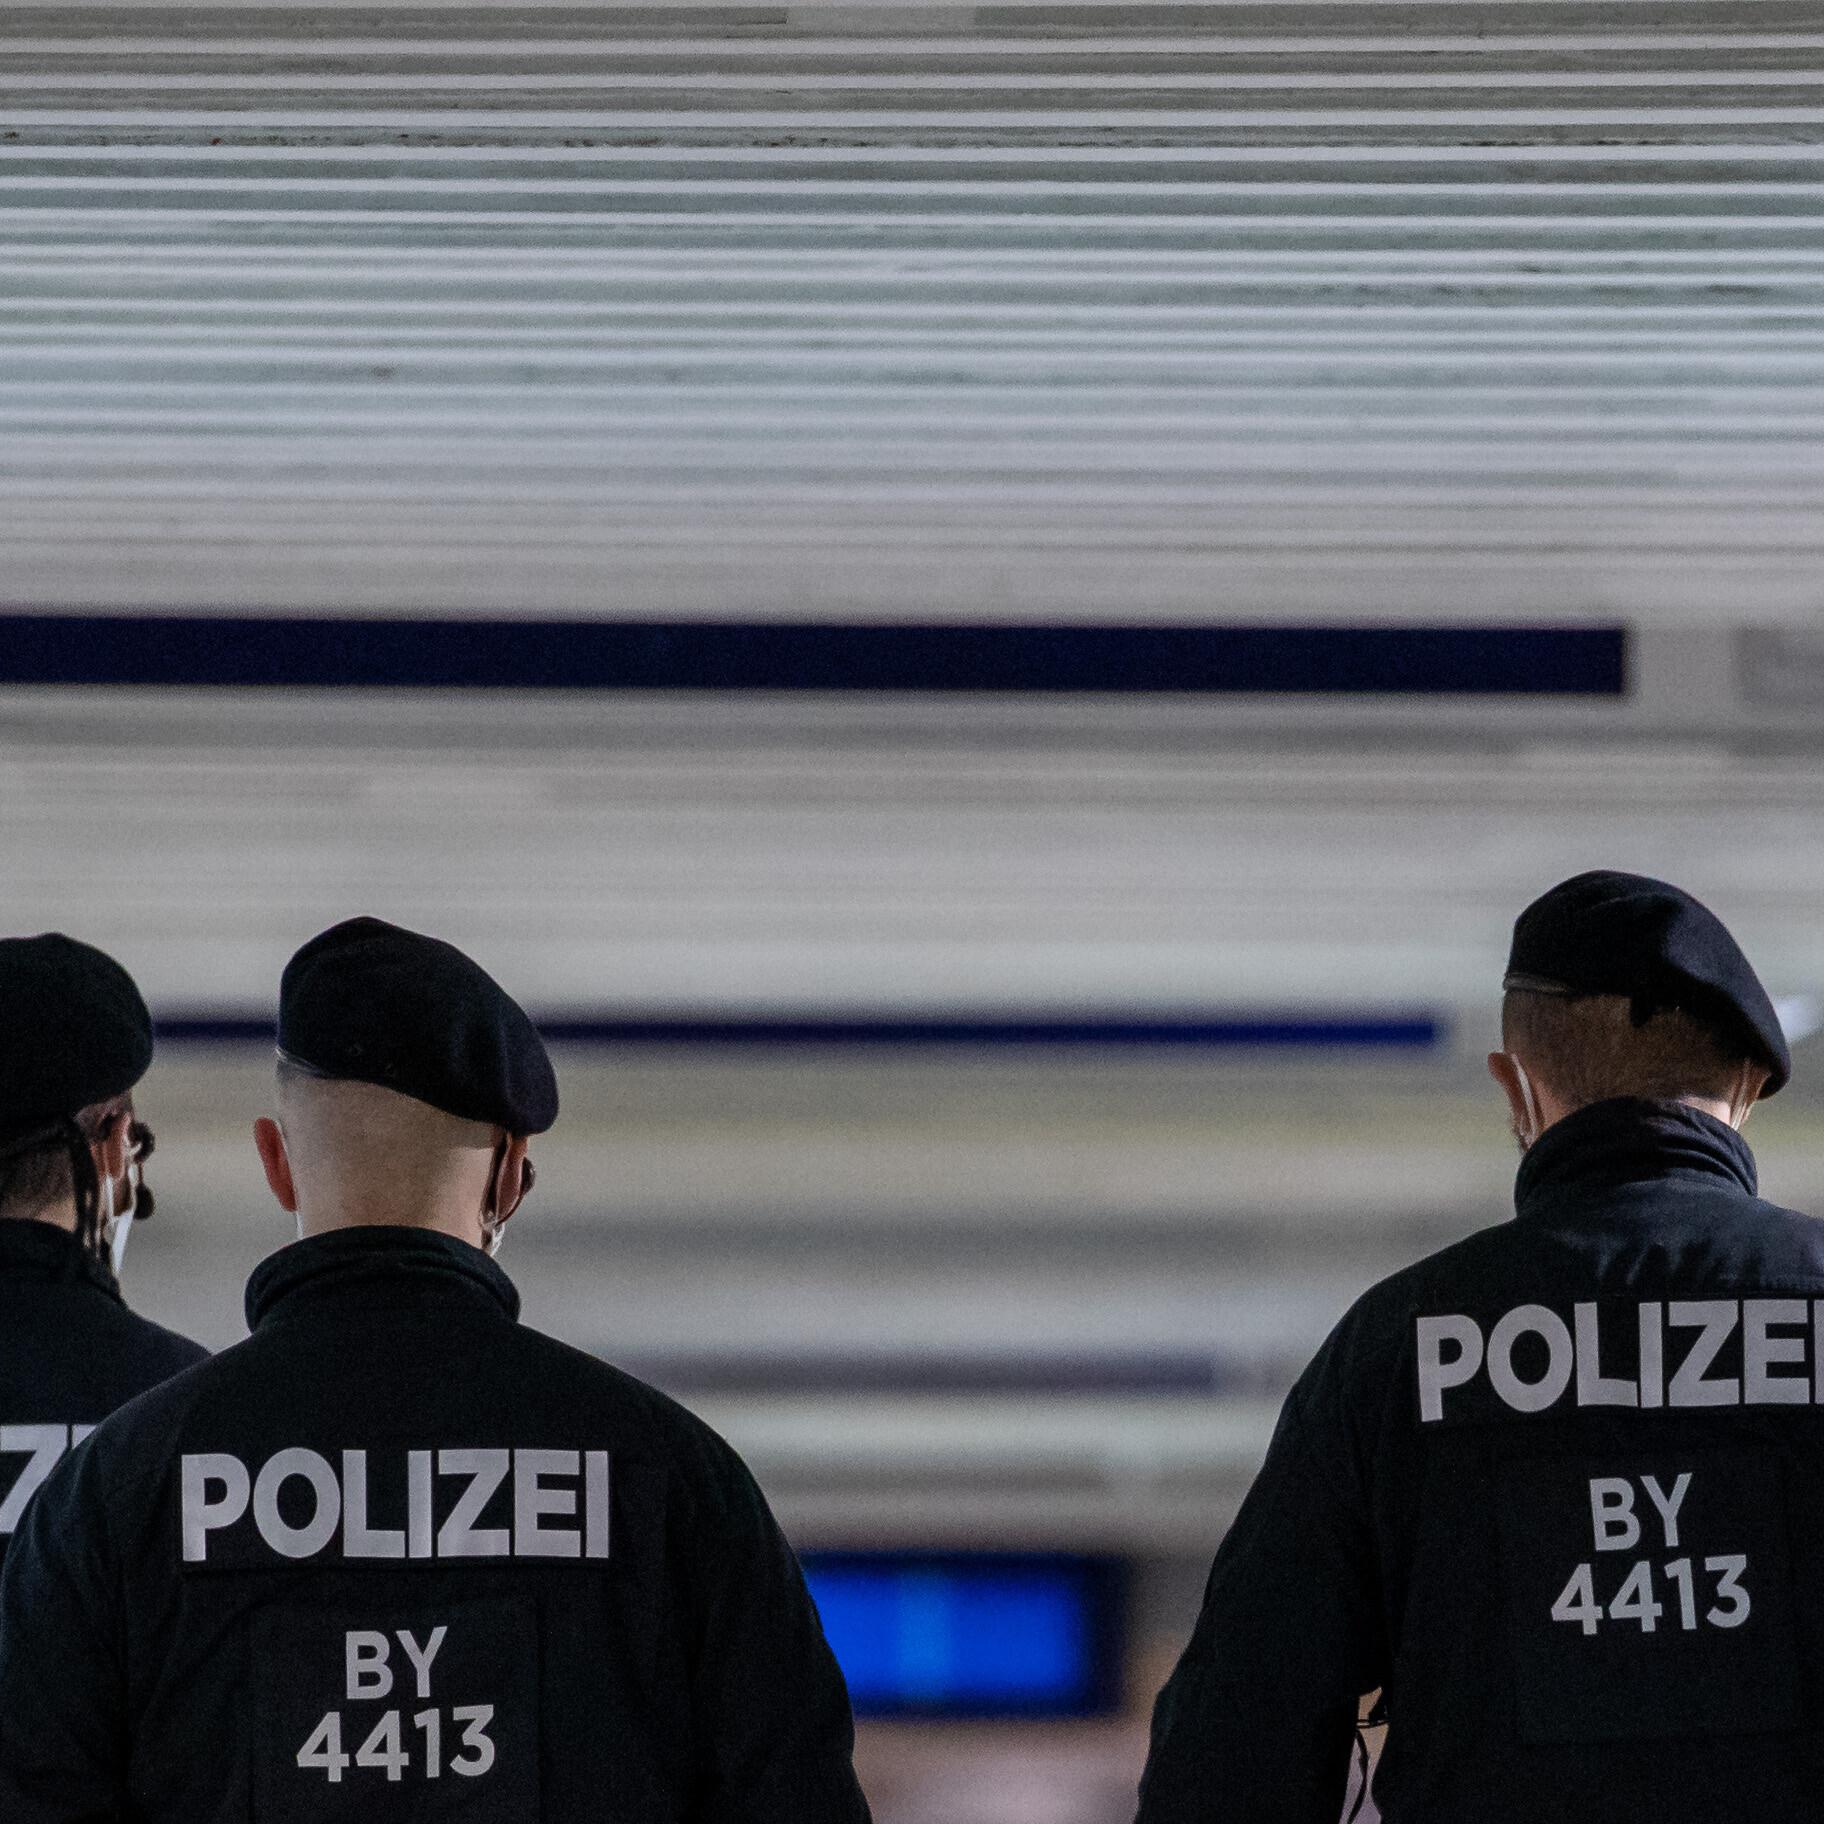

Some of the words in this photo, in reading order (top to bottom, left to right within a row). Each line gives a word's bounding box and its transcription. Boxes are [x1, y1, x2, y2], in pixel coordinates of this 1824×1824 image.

[181, 1447, 610, 1562] POLIZEI
[1589, 1472, 1693, 1551] BY
[1550, 1554, 1751, 1636] 4413
[345, 1625, 448, 1700] BY
[296, 1704, 496, 1783] 4413
